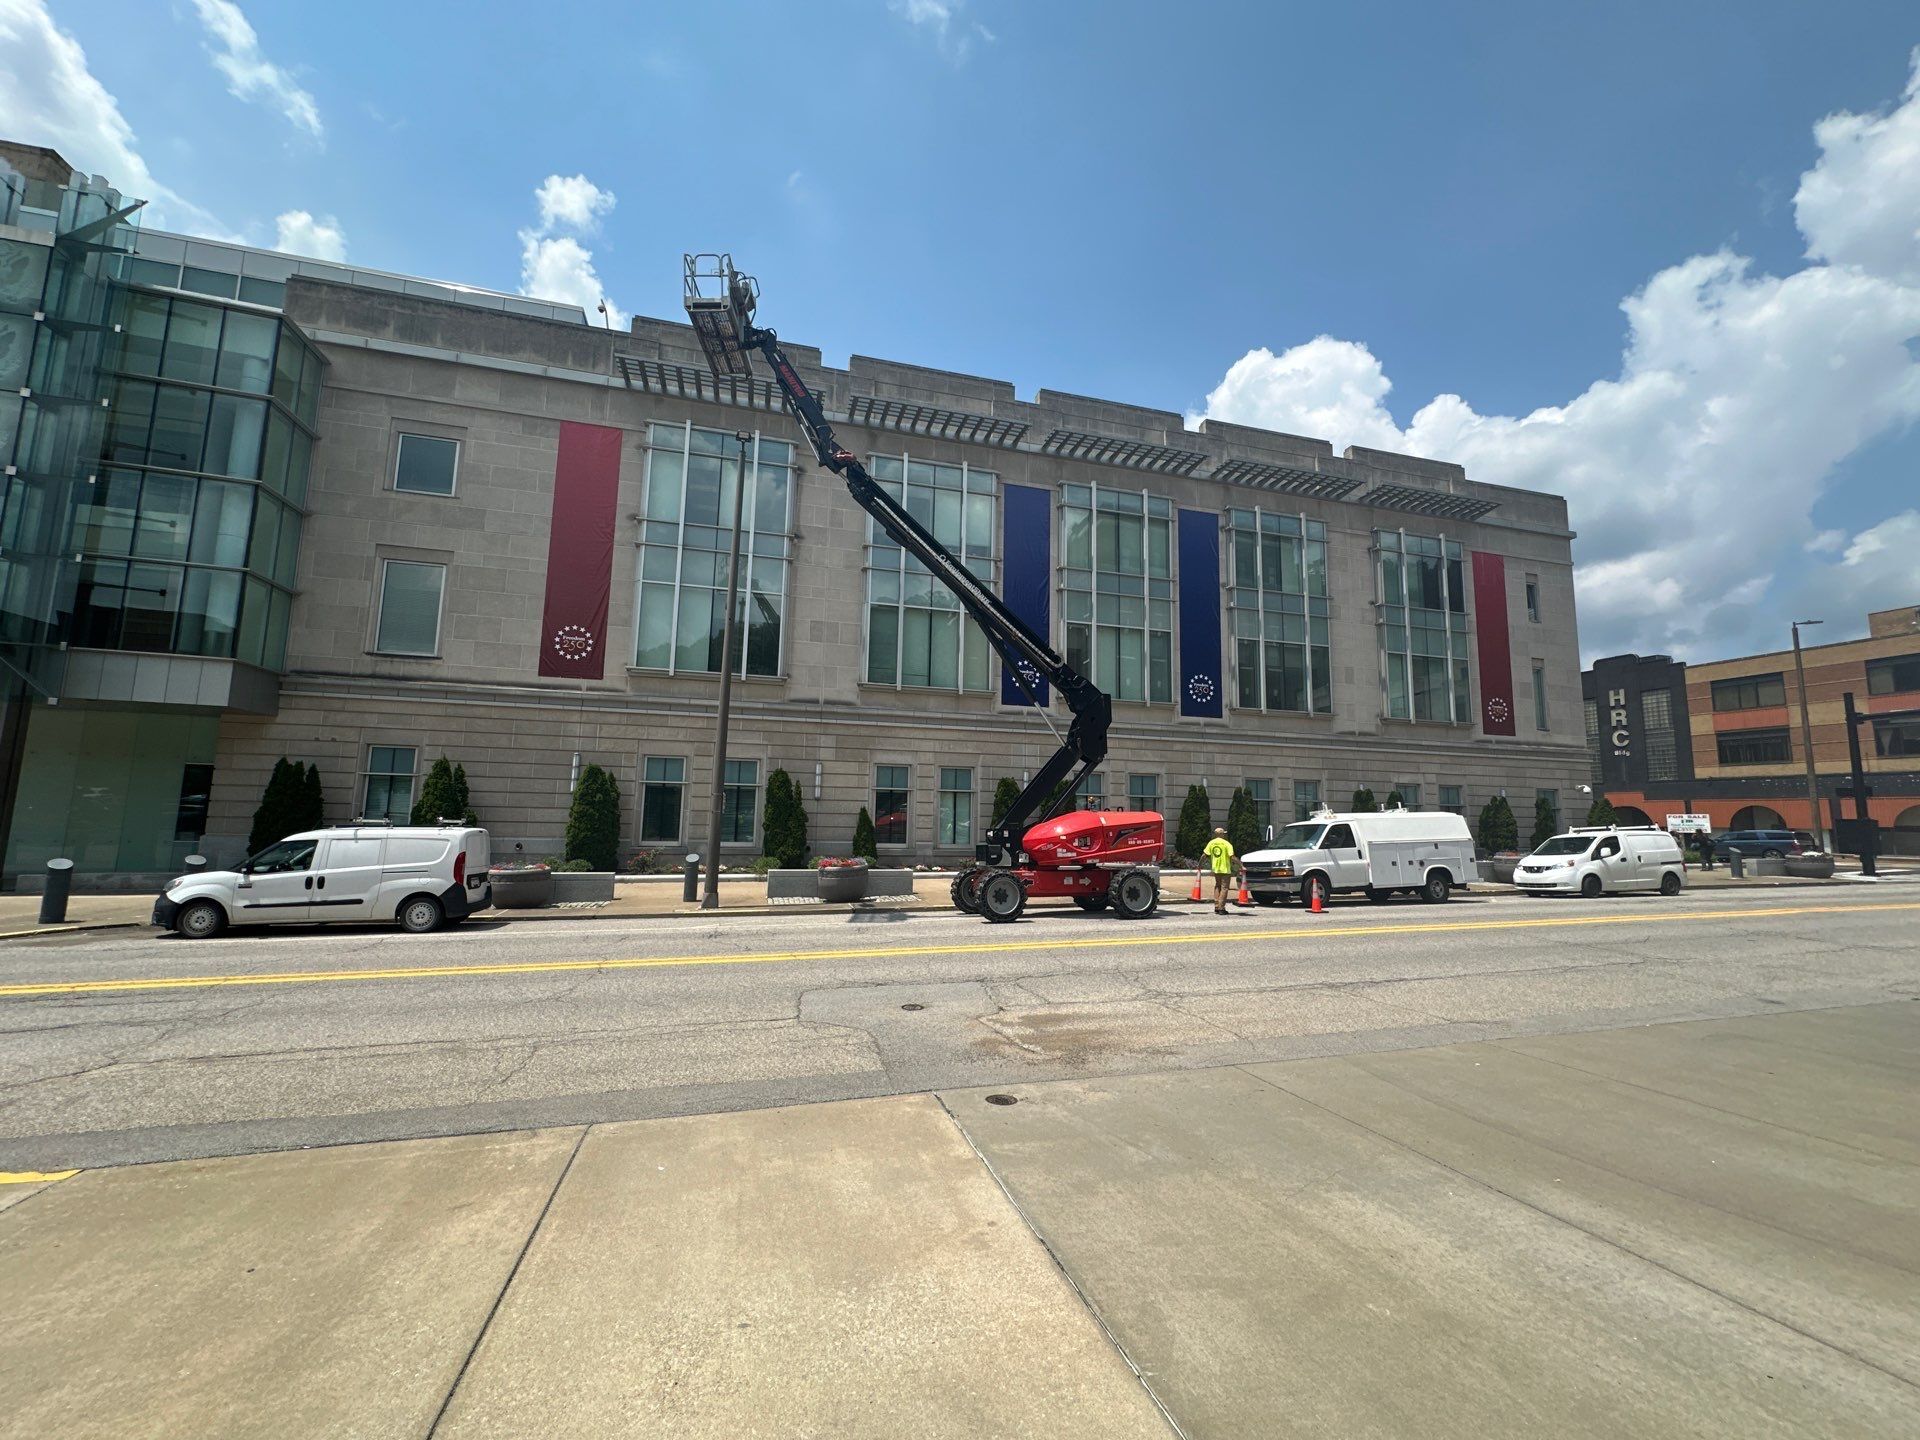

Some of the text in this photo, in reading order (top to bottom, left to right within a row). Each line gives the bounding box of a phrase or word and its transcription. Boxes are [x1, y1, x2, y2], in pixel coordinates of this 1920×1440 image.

[563, 640, 586, 651] 250
[1194, 687, 1209, 696] 250
[1609, 688, 1630, 747] HRC
